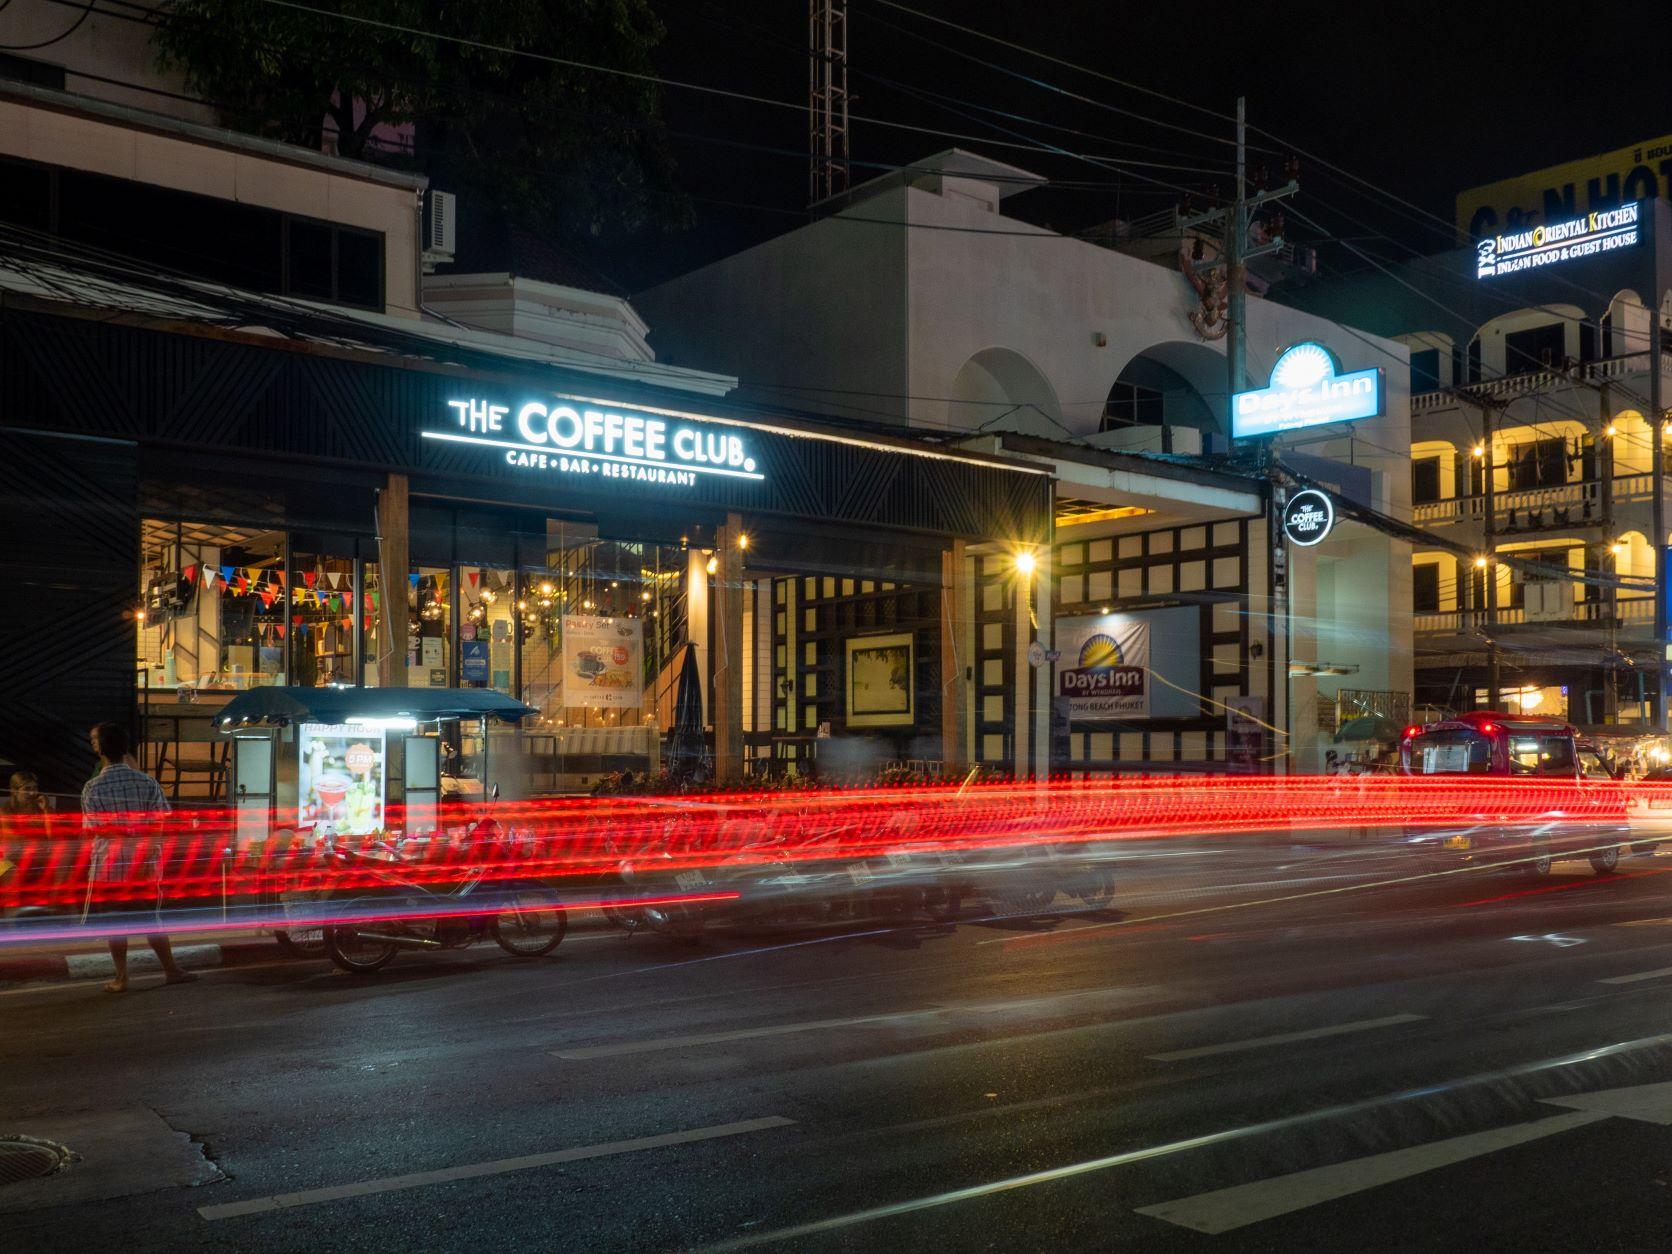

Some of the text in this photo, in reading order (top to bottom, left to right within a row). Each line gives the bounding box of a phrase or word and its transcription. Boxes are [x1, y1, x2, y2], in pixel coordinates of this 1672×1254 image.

[1588, 205, 1638, 232] KITCHEN
[1532, 250, 1560, 268] FOOD
[1560, 247, 1569, 260] &
[1569, 240, 1602, 258] GUEST
[1602, 231, 1638, 251] HOUSE
[1321, 375, 1373, 401] Inn
[448, 398, 509, 433] THE
[518, 402, 667, 461] COFFEE
[506, 450, 697, 487] CAFE BAR RESTAURANT
[1290, 511, 1324, 524] COFFEE
[1300, 504, 1314, 513] THE
[1064, 669, 1140, 689] Days Inn
[1089, 702, 1114, 711] BEACH
[1115, 701, 1144, 710] PHUKET
[304, 723, 345, 733] HAPPY
